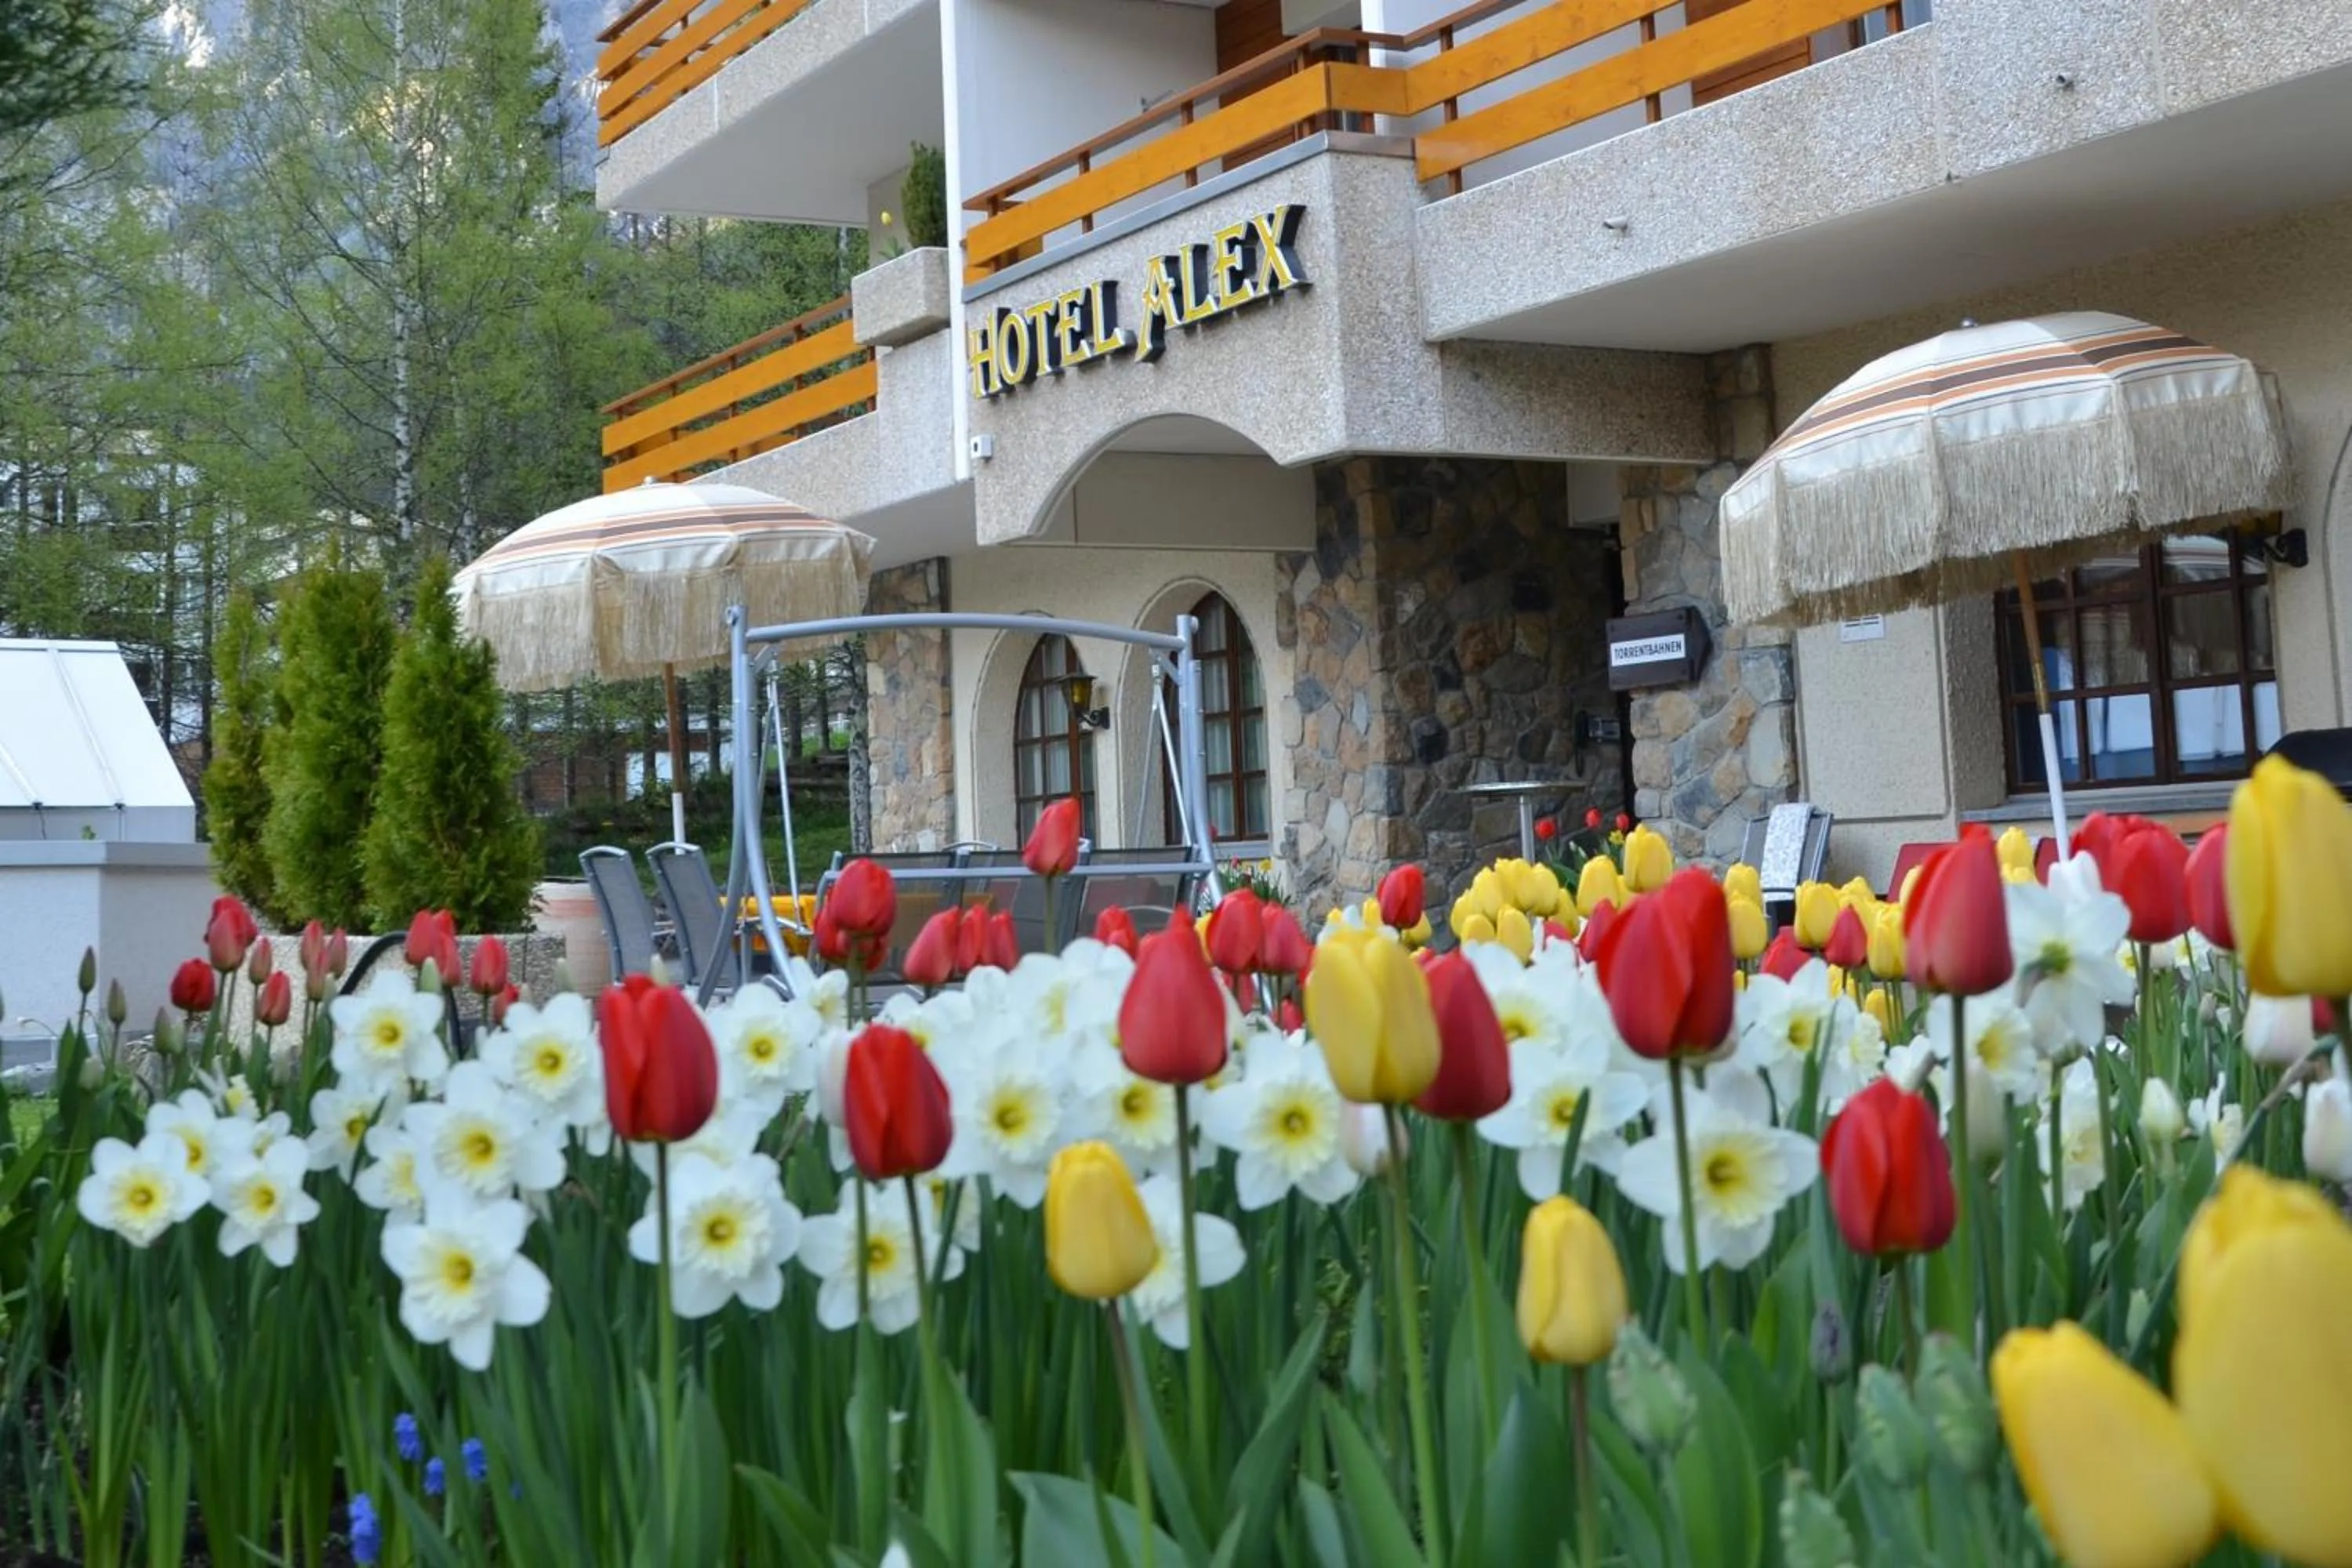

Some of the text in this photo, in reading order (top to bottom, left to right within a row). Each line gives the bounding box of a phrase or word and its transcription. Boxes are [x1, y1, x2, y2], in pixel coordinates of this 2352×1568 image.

[968, 204, 1309, 399] HOTEL ALEX
[1614, 641, 1682, 660] TORRENTBAHNEN
